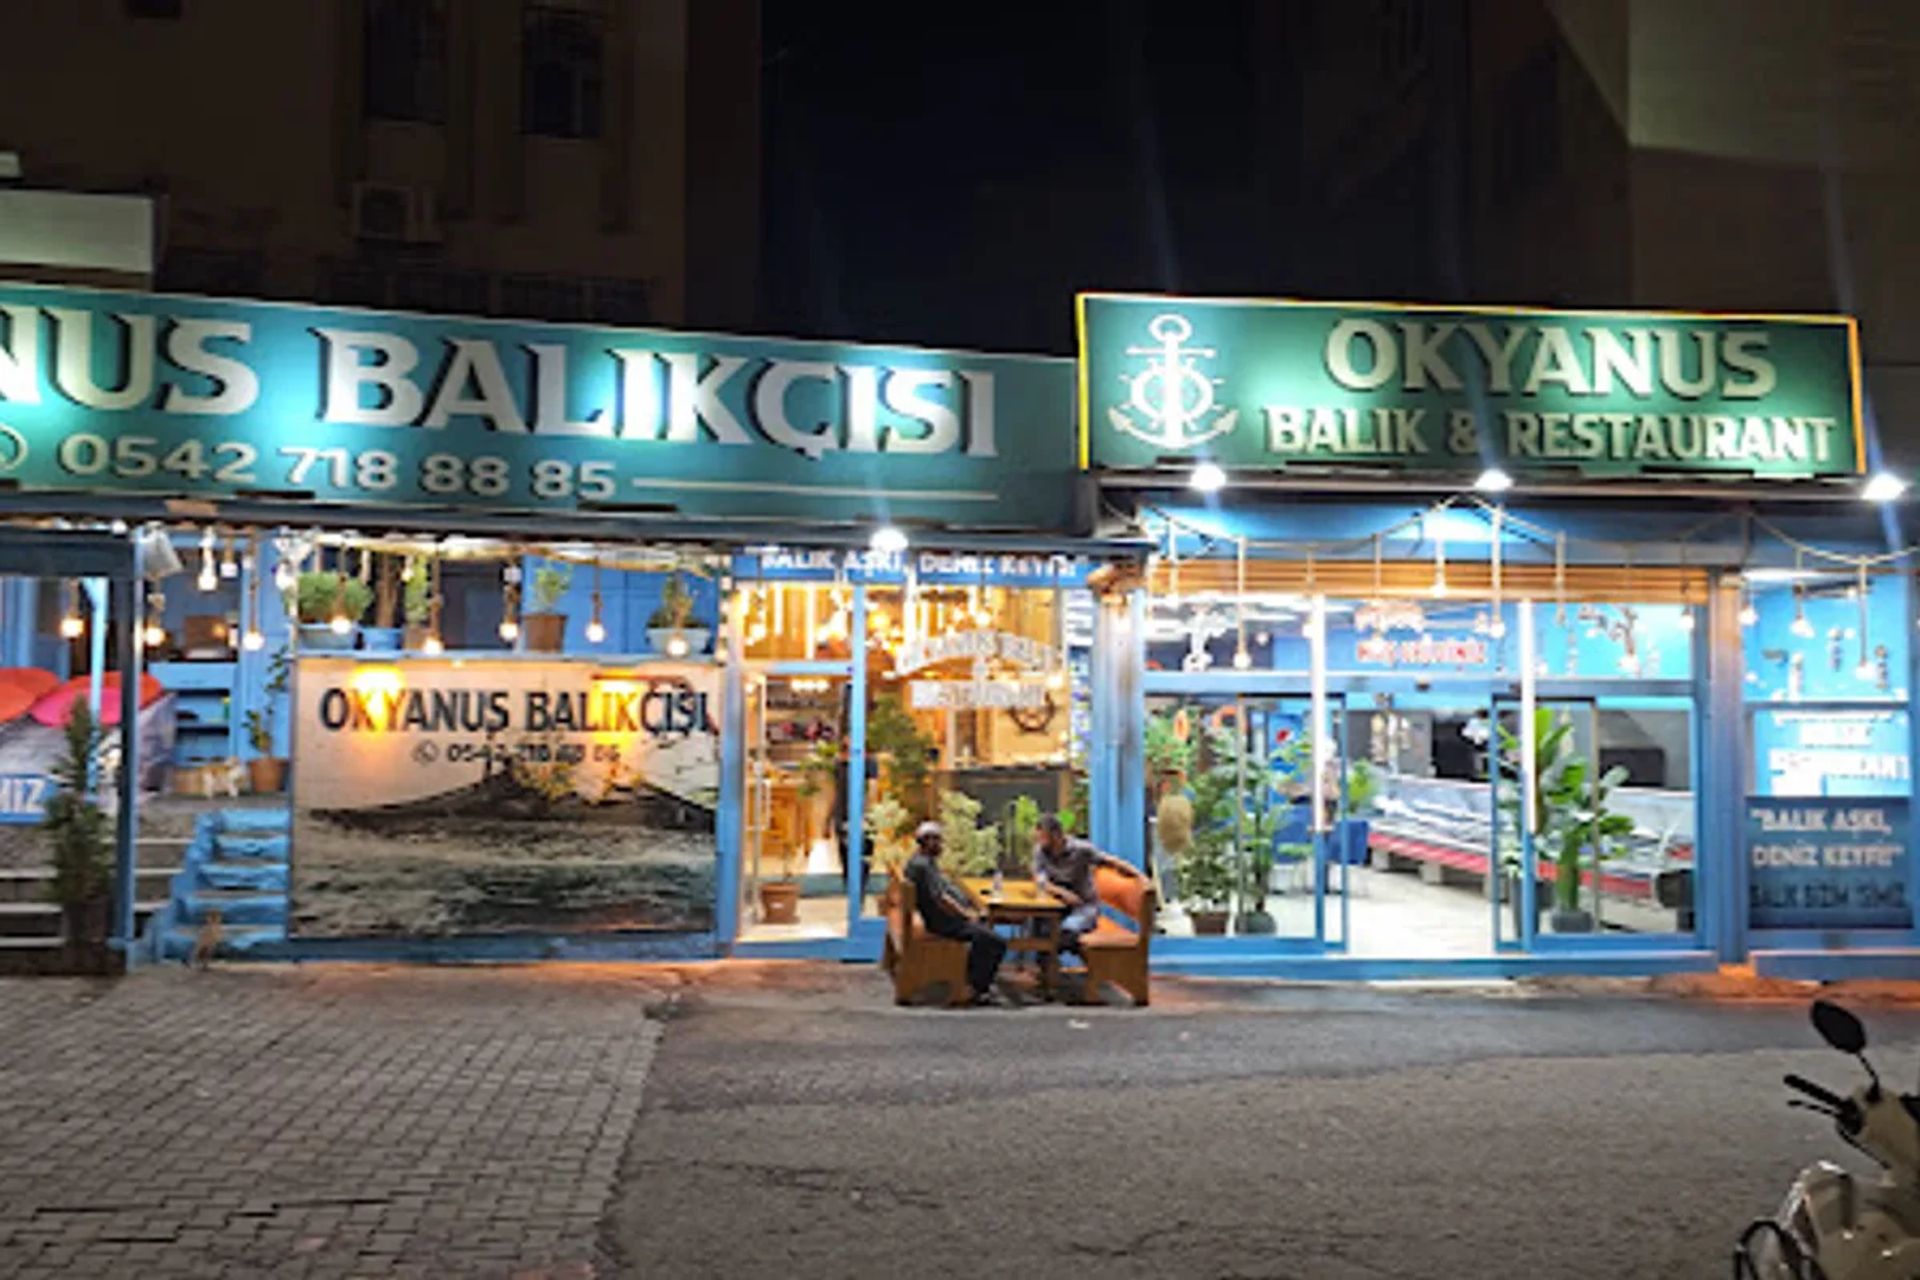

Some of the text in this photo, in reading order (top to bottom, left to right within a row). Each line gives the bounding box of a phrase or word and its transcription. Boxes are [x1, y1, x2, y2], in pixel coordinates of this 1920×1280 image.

[1324, 317, 1777, 398] OKYANUS
[312, 325, 999, 462] BALIKÇISI
[57, 433, 617, 501] 0542 718 88 85
[1264, 406, 1836, 463] BALIK & RESTAURANT
[318, 687, 710, 738] OKYANUS BALIKÇISI
